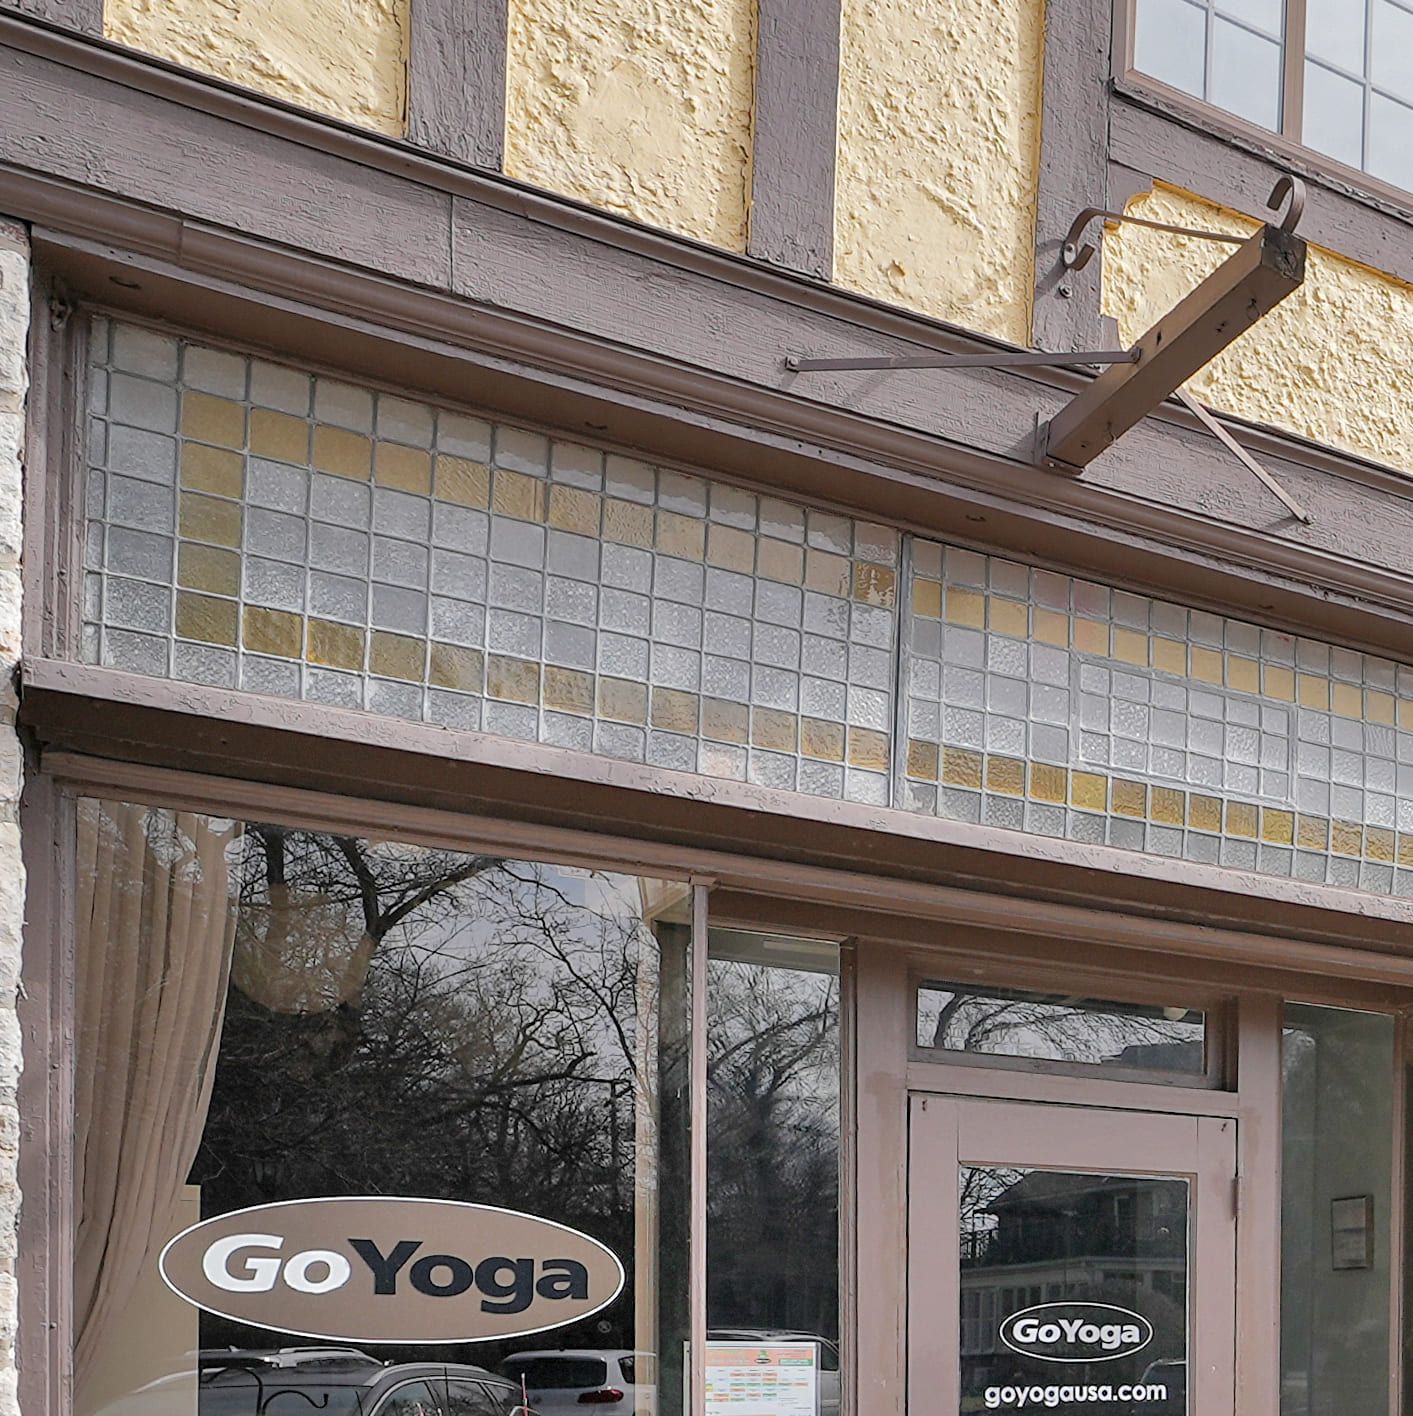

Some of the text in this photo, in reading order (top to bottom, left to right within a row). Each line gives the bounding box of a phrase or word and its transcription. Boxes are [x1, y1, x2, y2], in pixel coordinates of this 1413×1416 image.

[202, 1232, 589, 1314] GoYoga
[1012, 1318, 1140, 1350] GoYoga
[984, 1383, 1167, 1408] goyogausa.com
